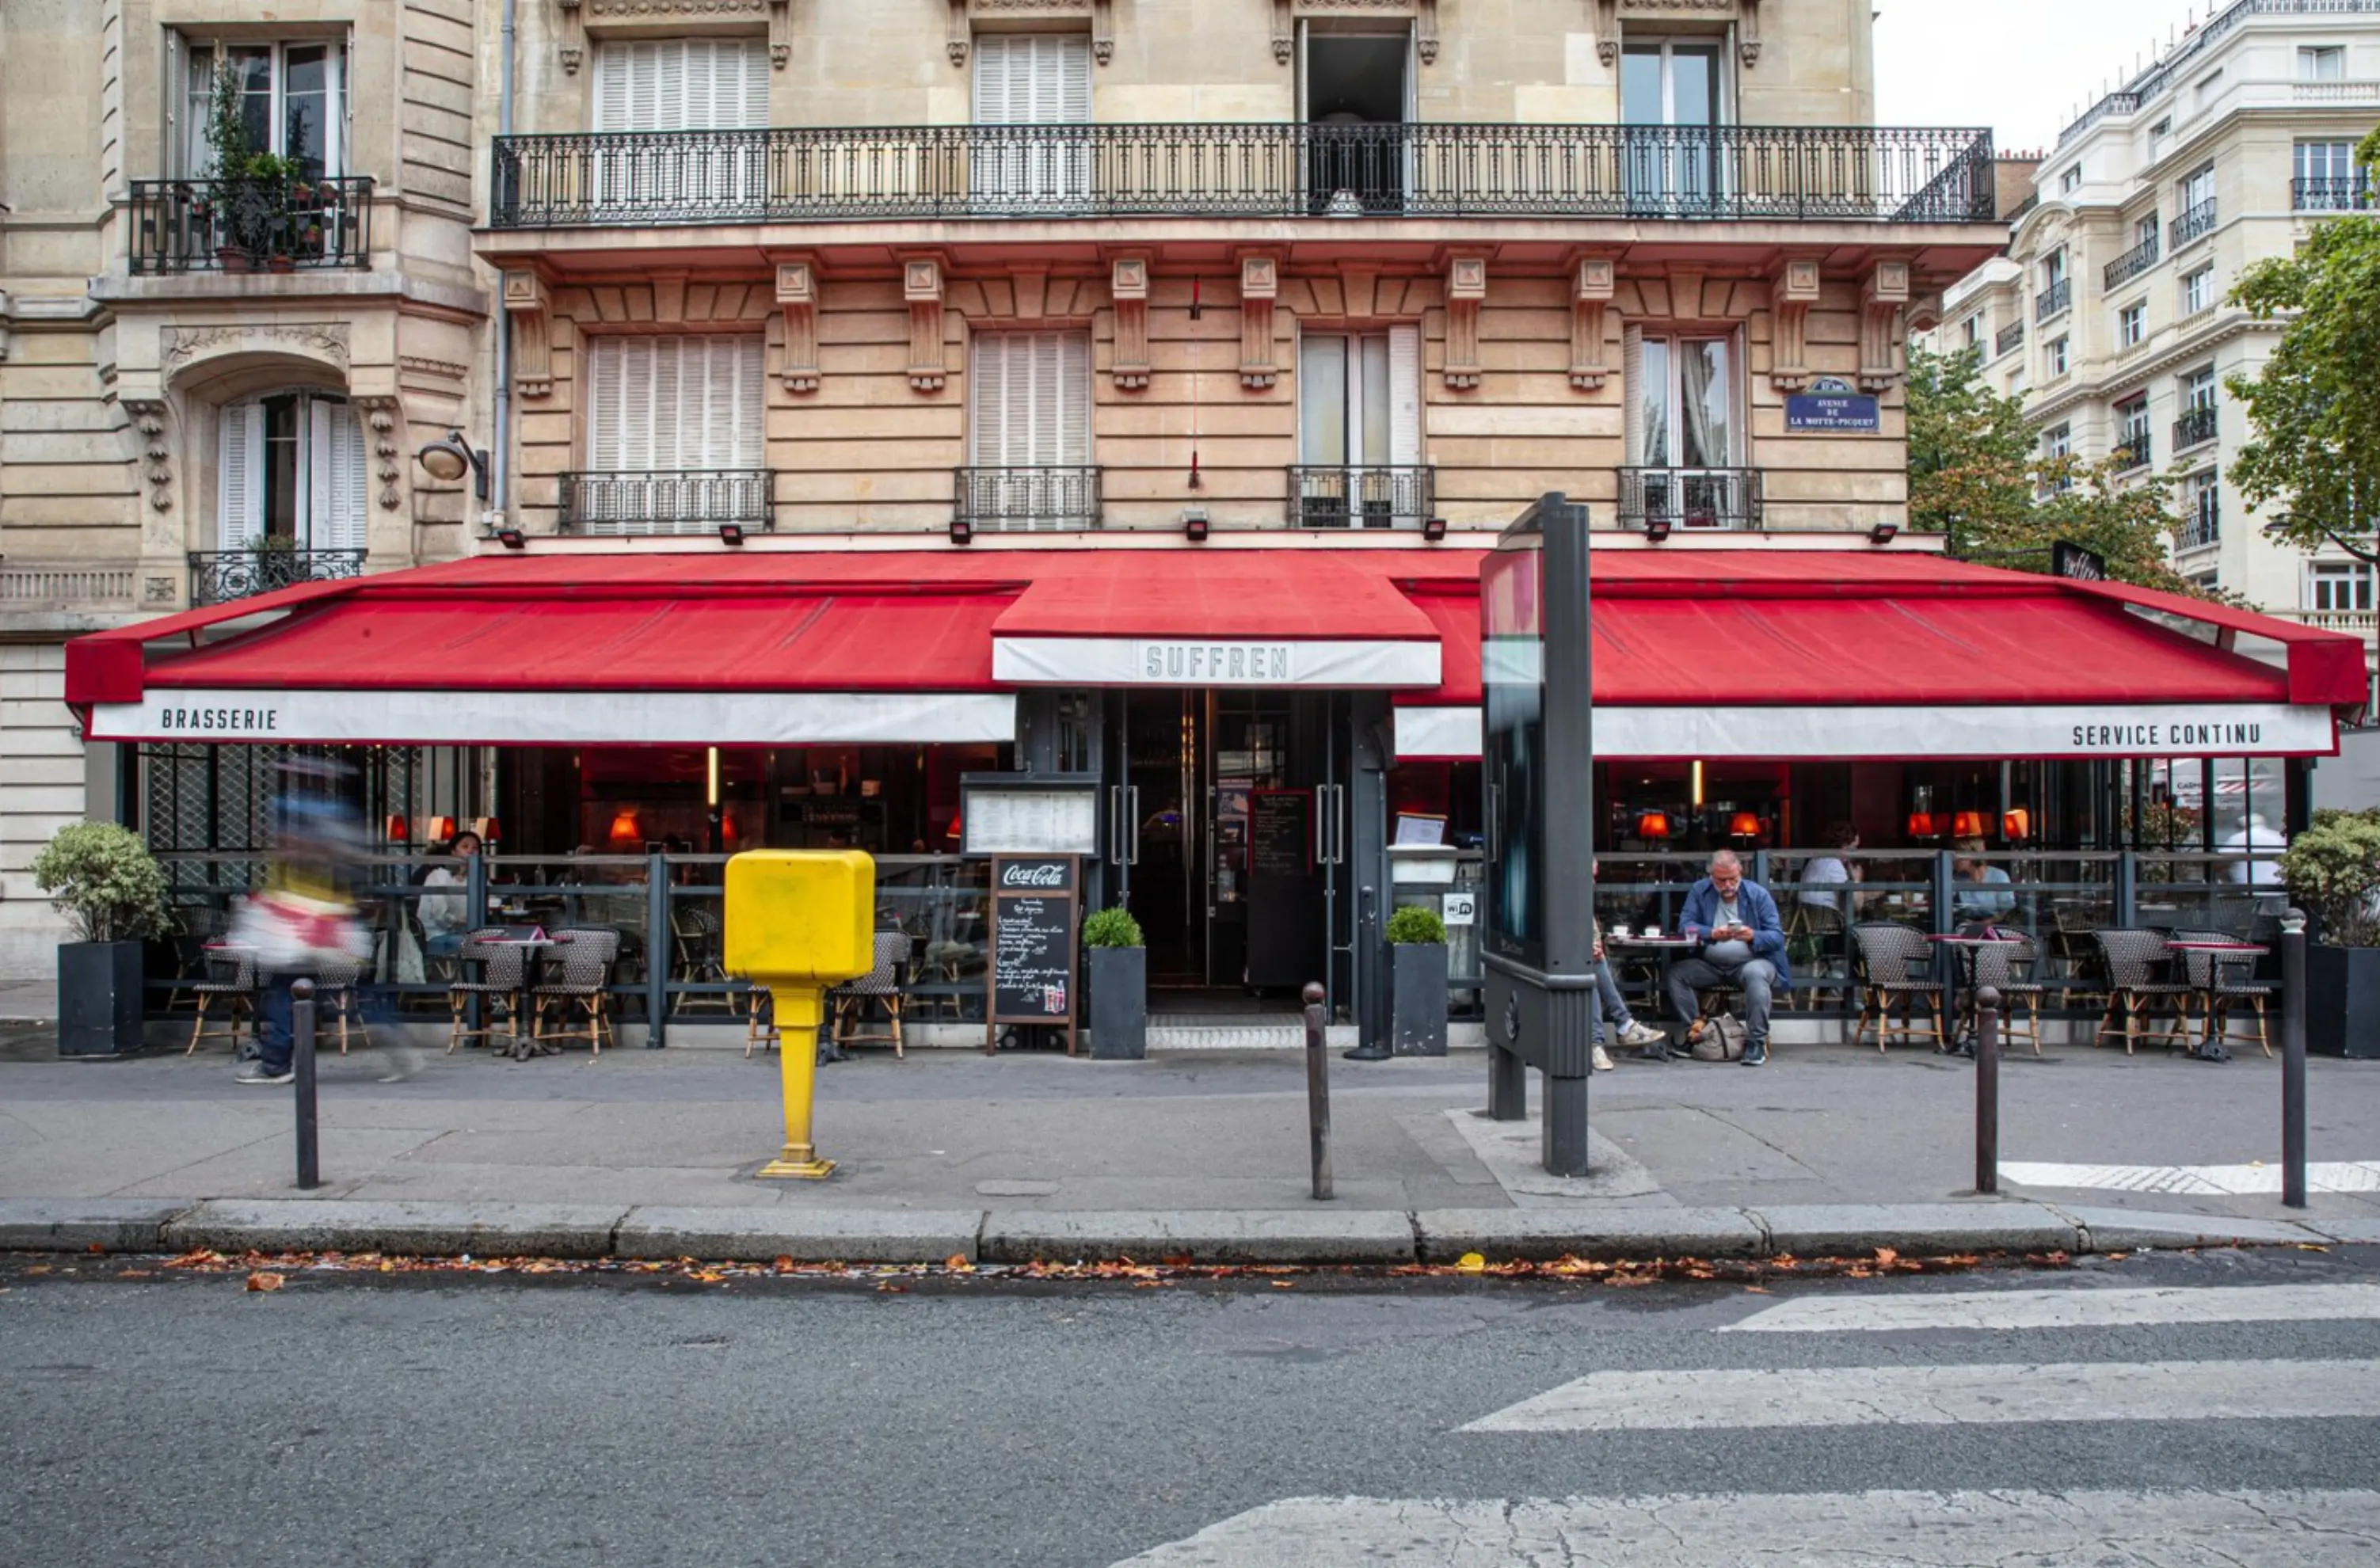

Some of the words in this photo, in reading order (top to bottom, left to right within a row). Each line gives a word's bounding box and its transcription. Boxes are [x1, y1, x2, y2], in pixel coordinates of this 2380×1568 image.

[1818, 399, 1849, 408] AVENUE
[1805, 417, 1875, 426] MOTTE-PICQUET
[1147, 645, 1287, 679] SUFFREN
[162, 709, 277, 729] BRASSERIE
[2073, 725, 2159, 745] SERVICE
[2170, 723, 2260, 744] CONTINU
